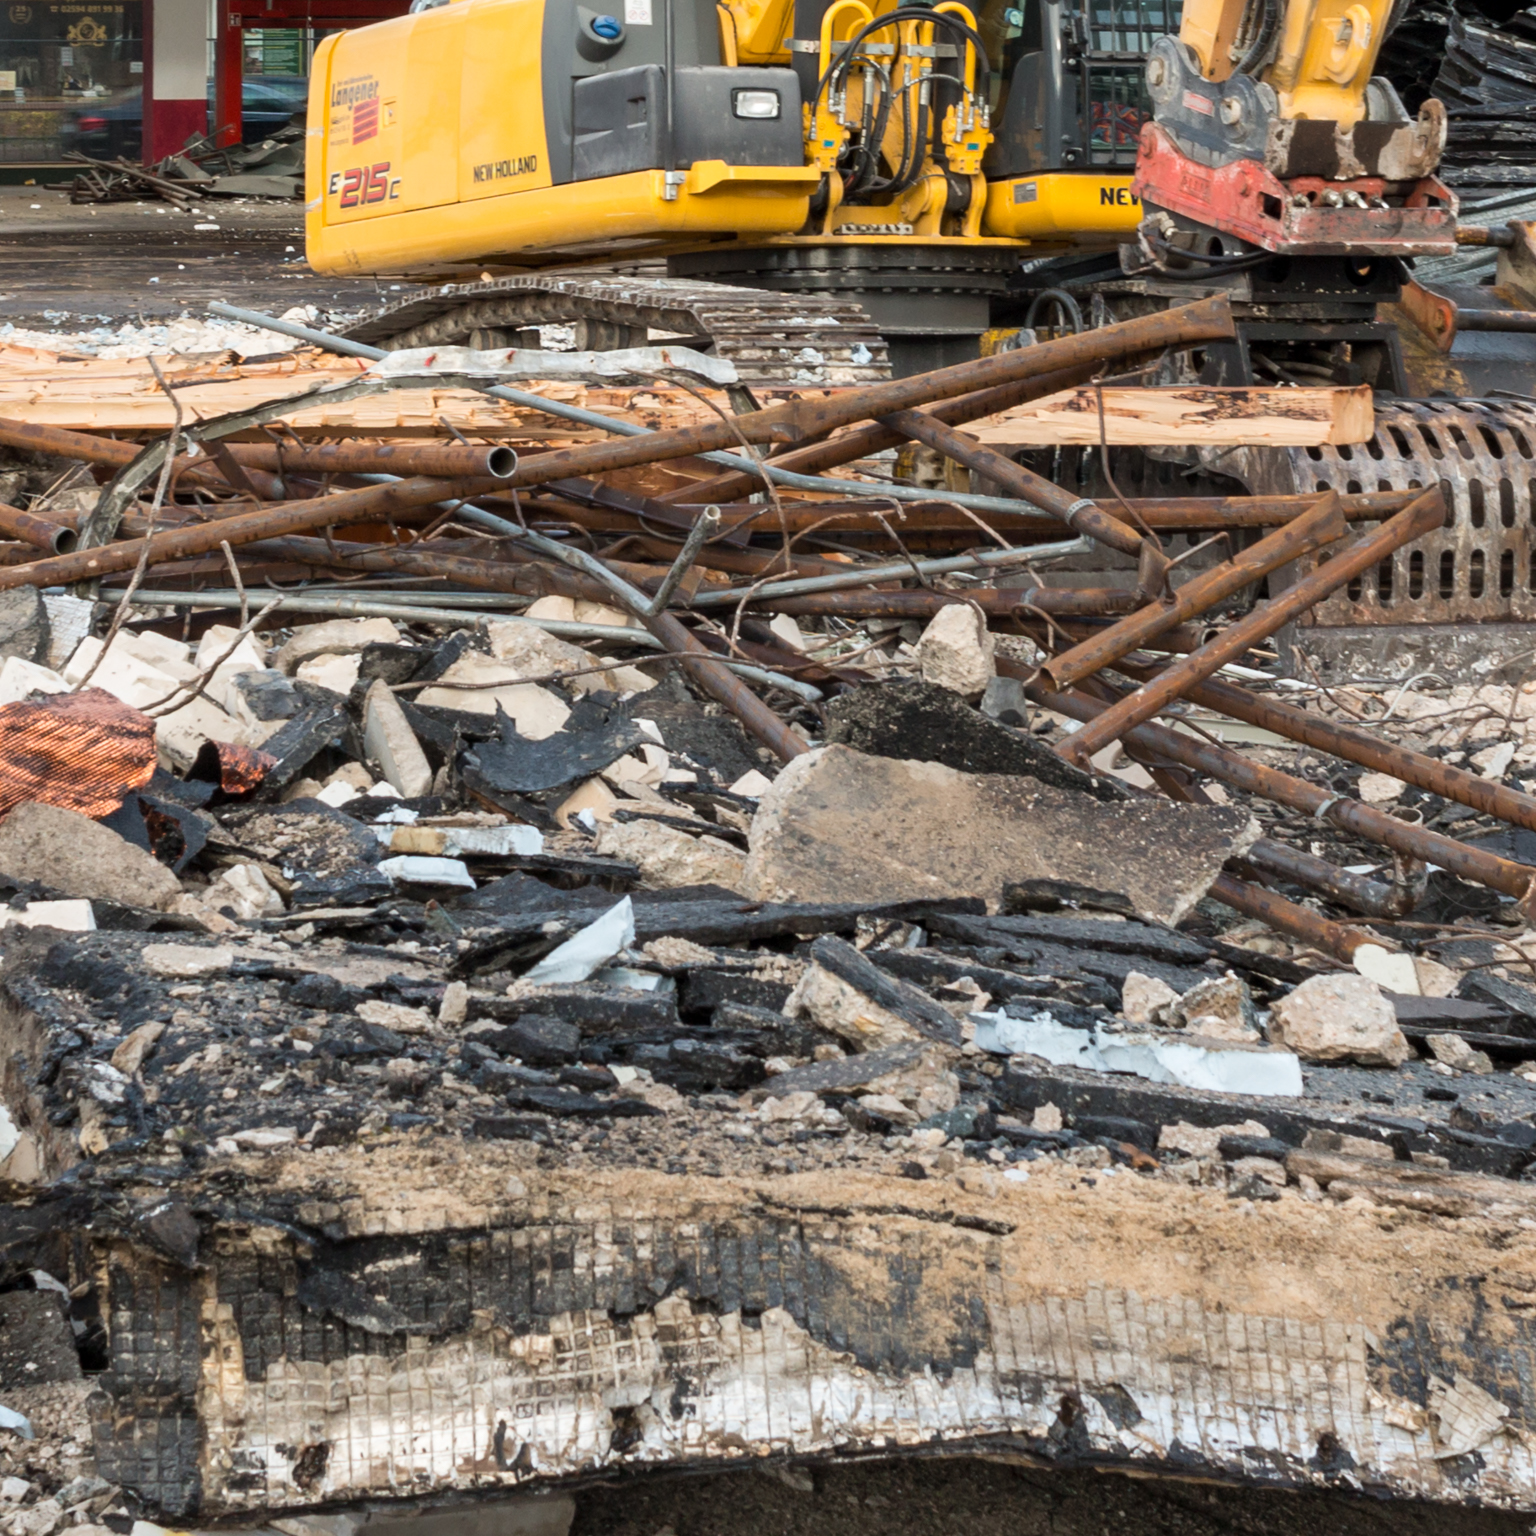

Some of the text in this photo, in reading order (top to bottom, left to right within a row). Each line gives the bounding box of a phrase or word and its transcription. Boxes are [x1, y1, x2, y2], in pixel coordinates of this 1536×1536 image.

[331, 80, 379, 111] Langener
[473, 154, 538, 184] NEW HOLLAND
